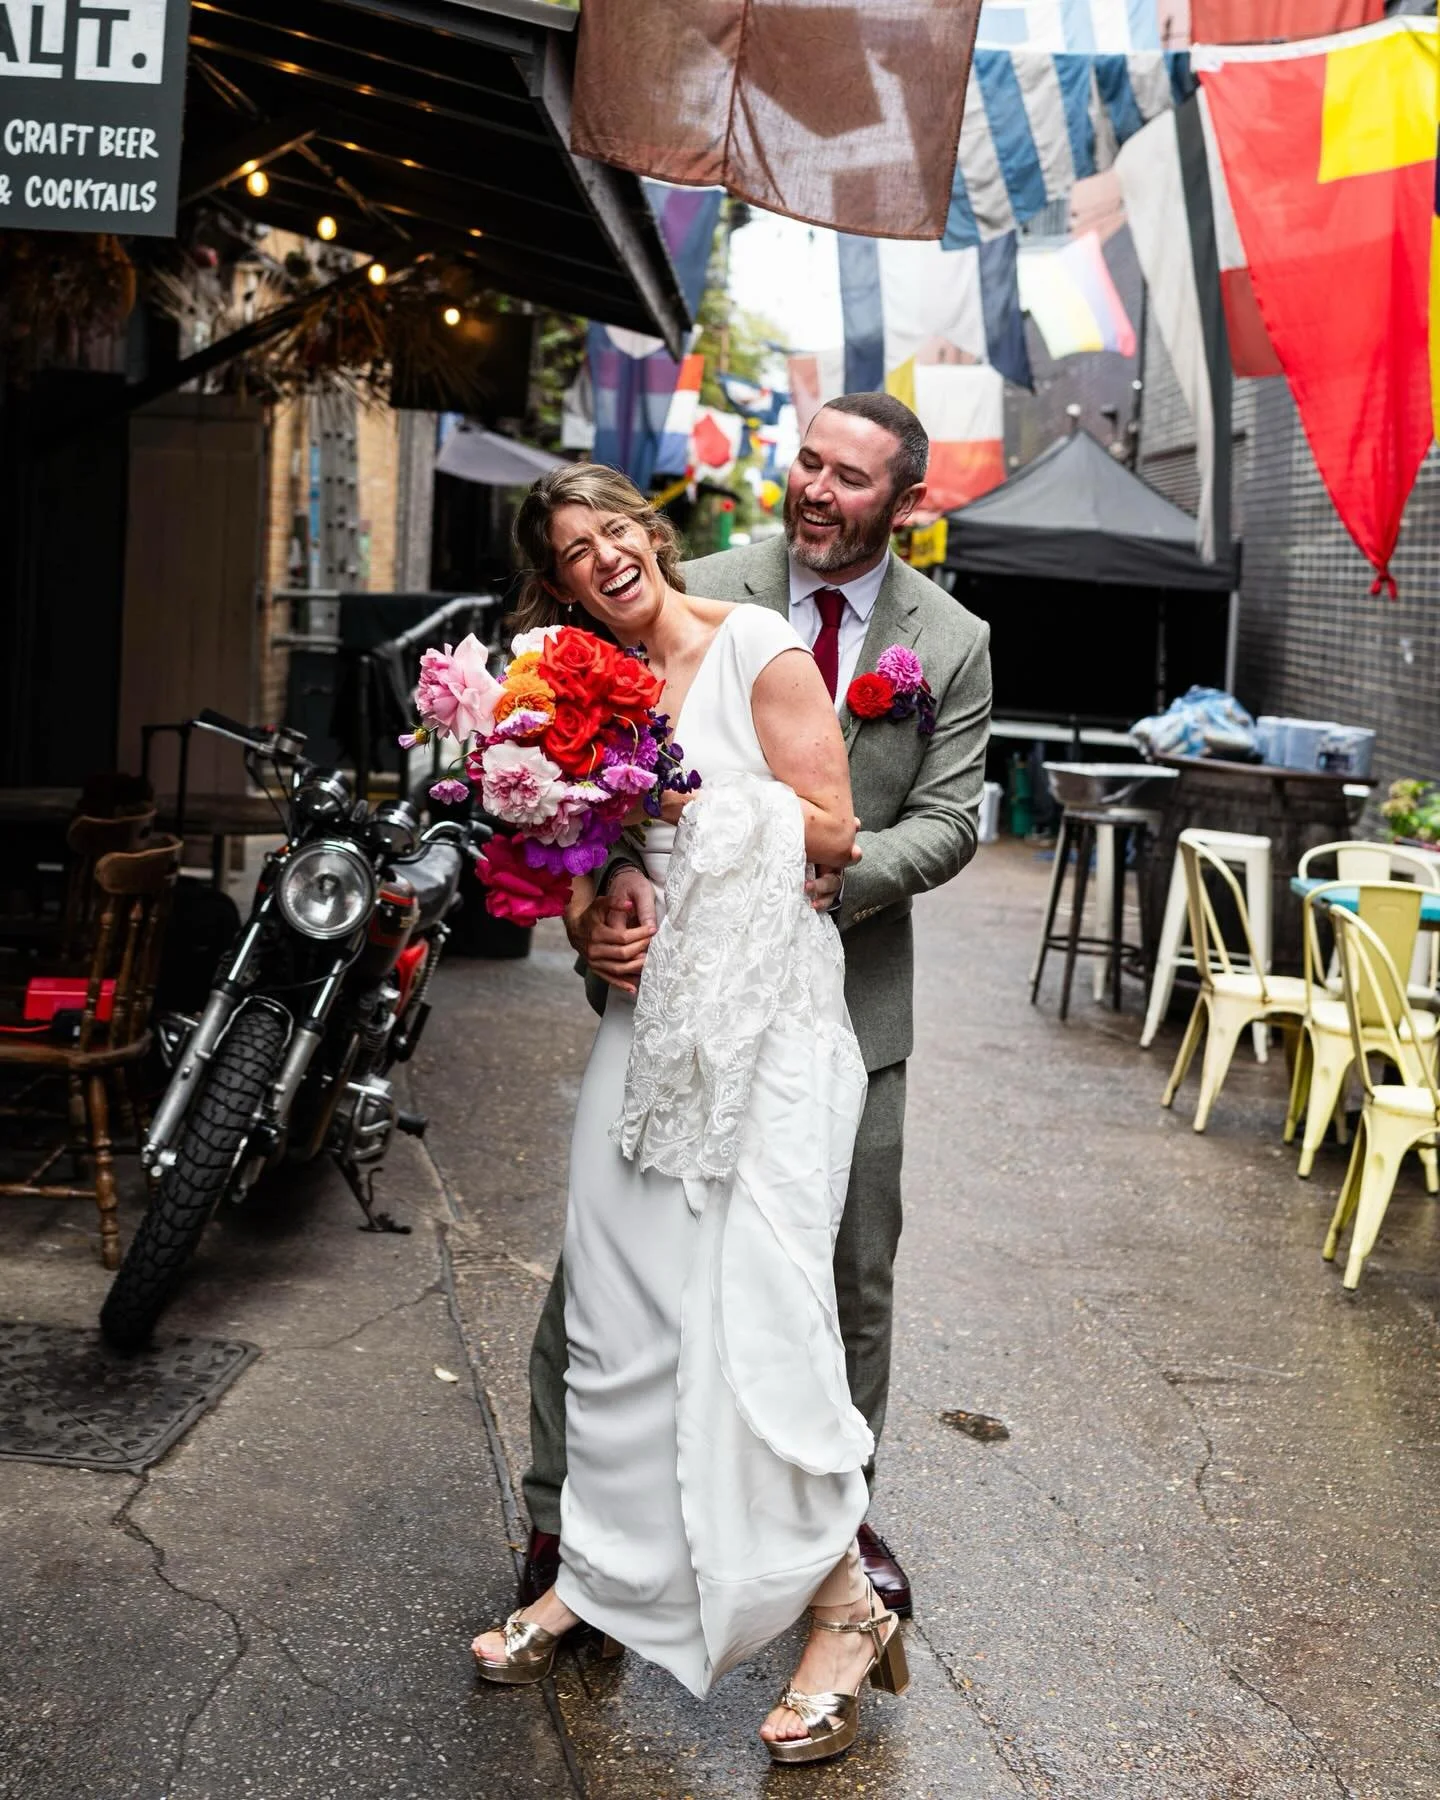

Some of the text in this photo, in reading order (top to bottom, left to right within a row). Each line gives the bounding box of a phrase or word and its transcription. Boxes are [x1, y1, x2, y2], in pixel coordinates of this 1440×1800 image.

[4, 118, 159, 159] CRAFT BEER
[24, 175, 157, 213] COCKTAILS
